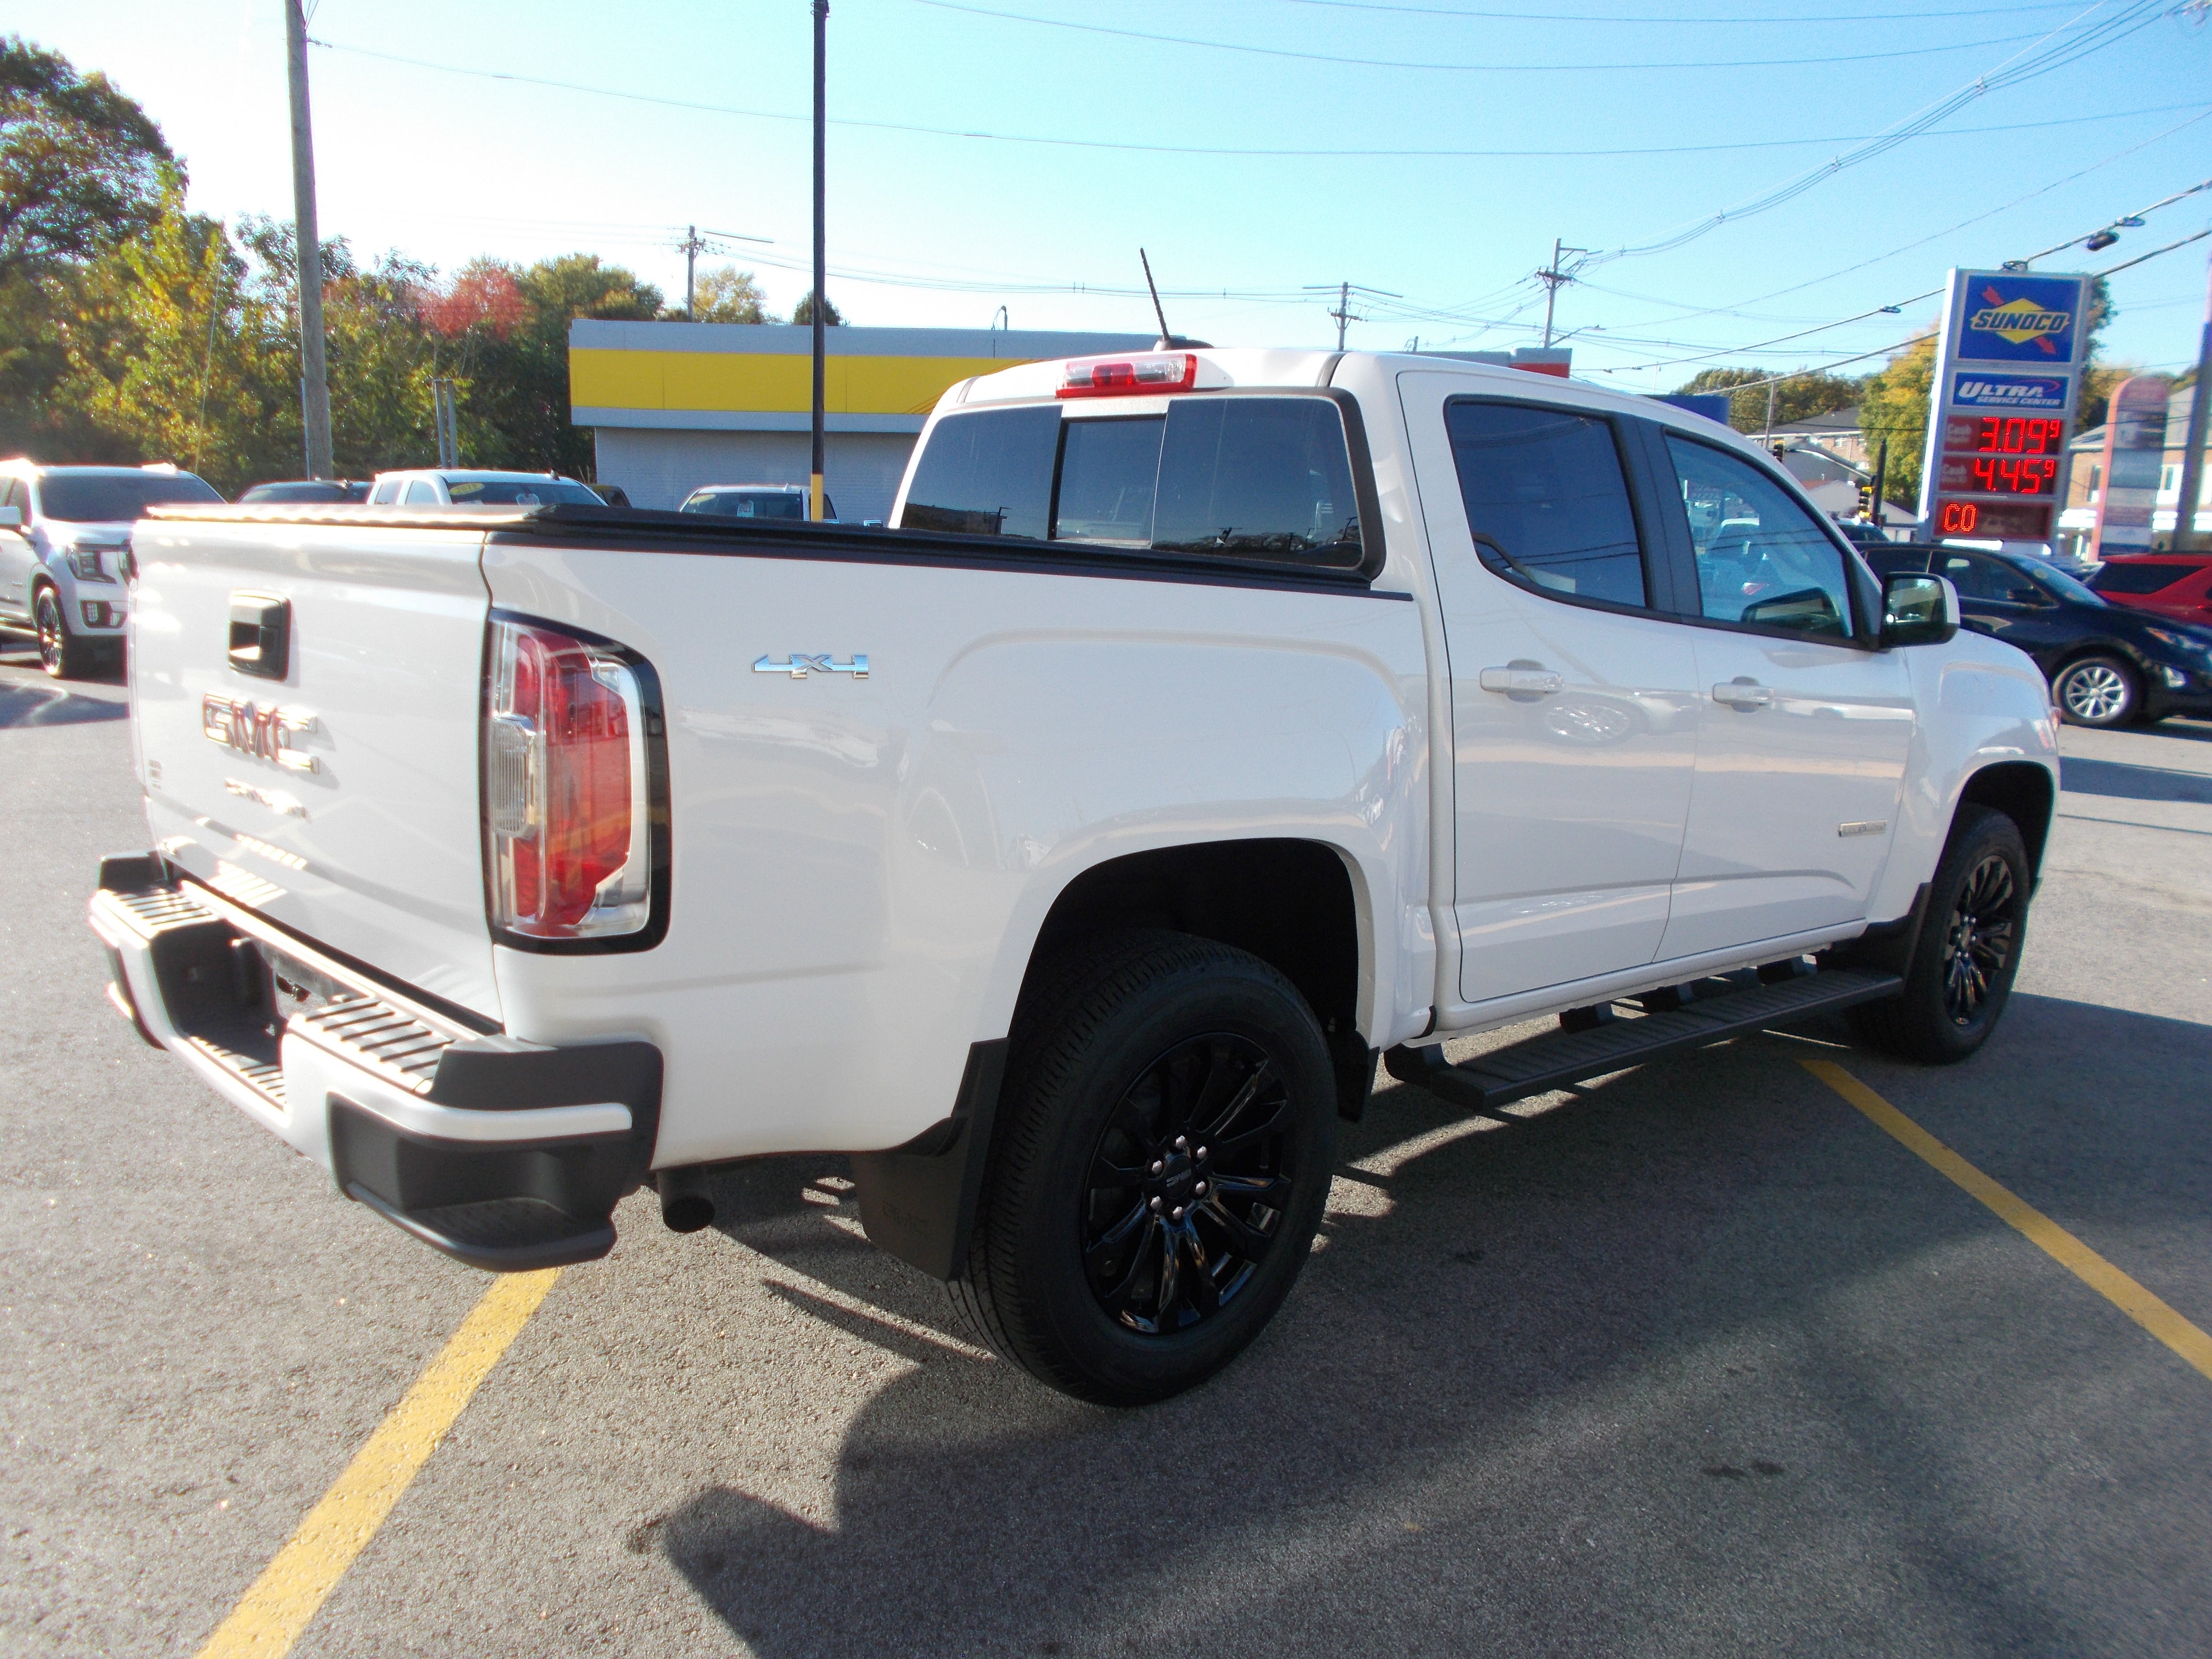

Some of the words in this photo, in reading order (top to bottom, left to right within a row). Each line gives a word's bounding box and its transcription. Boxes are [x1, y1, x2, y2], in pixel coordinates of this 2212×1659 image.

[1974, 311, 2065, 331] SUNOCO
[1959, 382, 2044, 397] ULTRA
[1975, 396, 2019, 404] SERVICE
[203, 692, 319, 774] GMC
